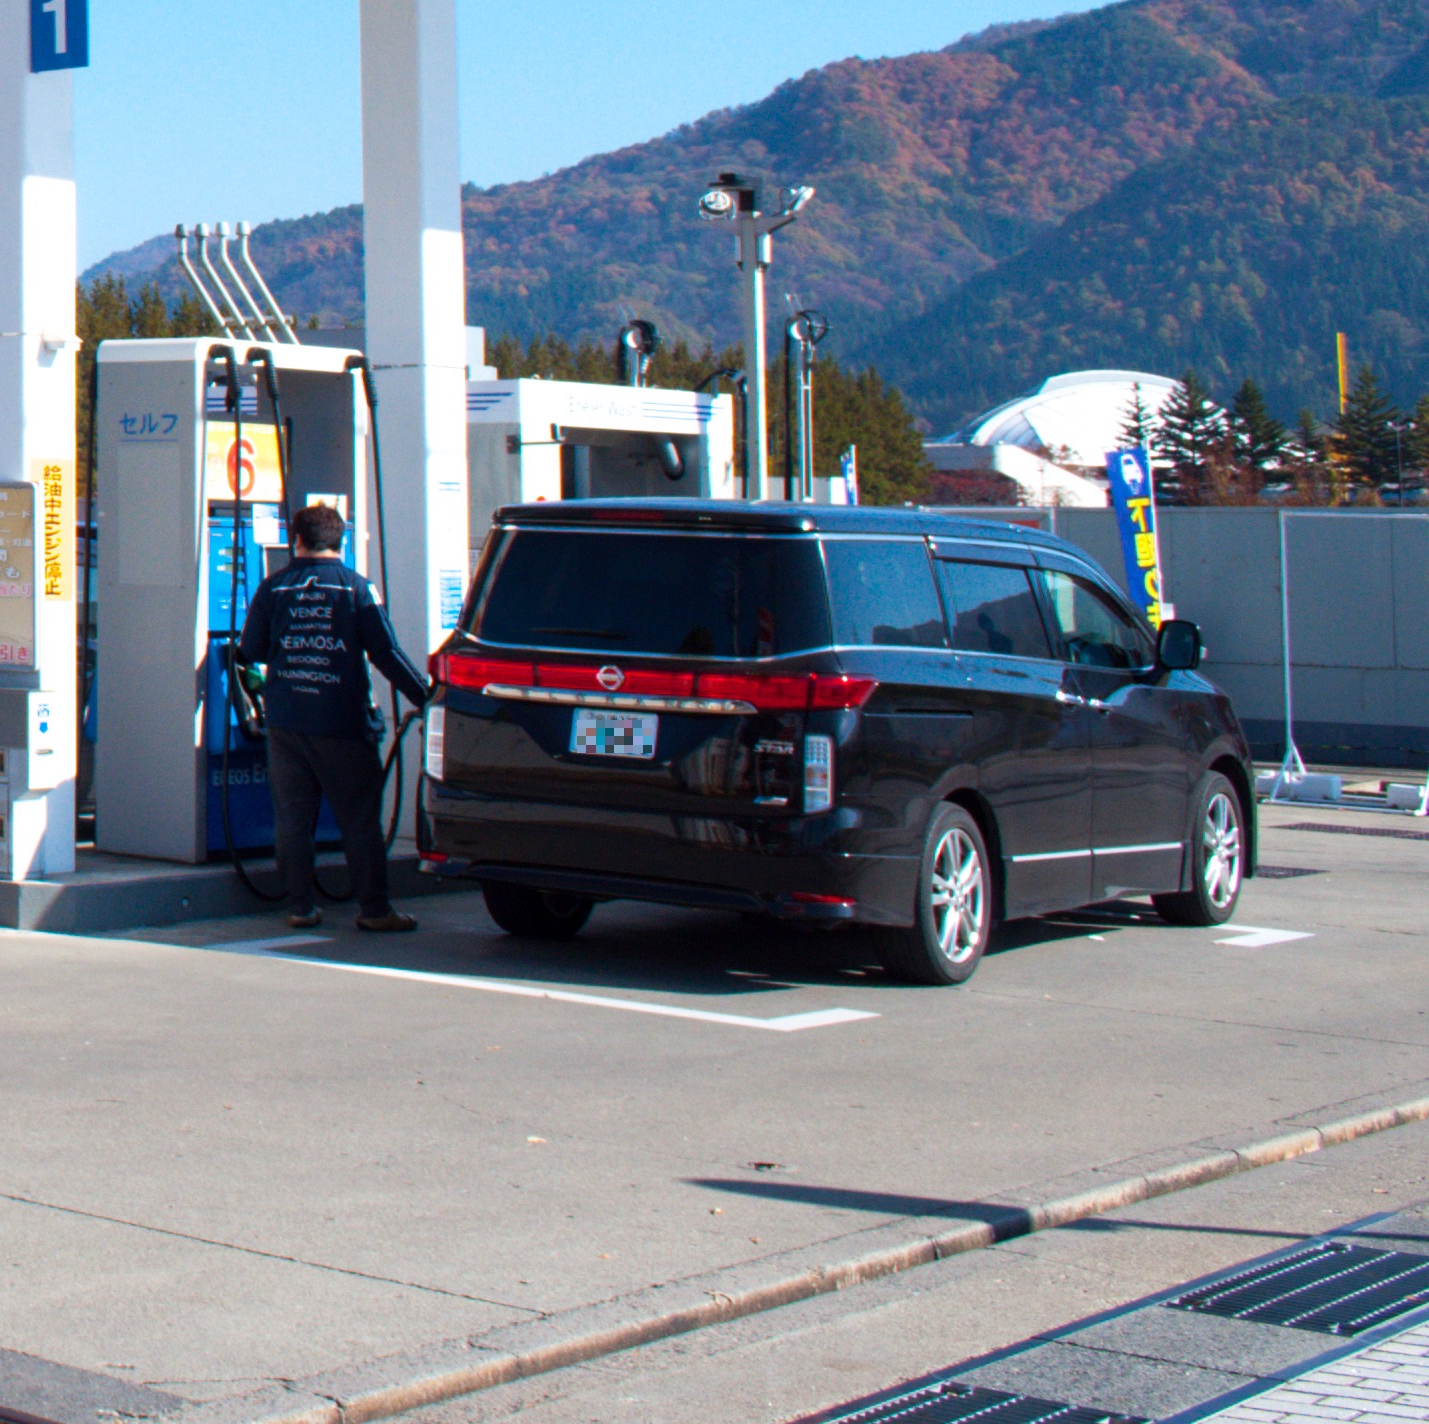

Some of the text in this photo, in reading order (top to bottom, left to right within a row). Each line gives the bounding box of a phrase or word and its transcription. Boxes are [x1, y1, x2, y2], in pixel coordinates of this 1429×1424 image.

[119, 412, 179, 436] セルフ
[226, 438, 255, 497] 6
[43, 463, 62, 596] 給油中エンジン停止
